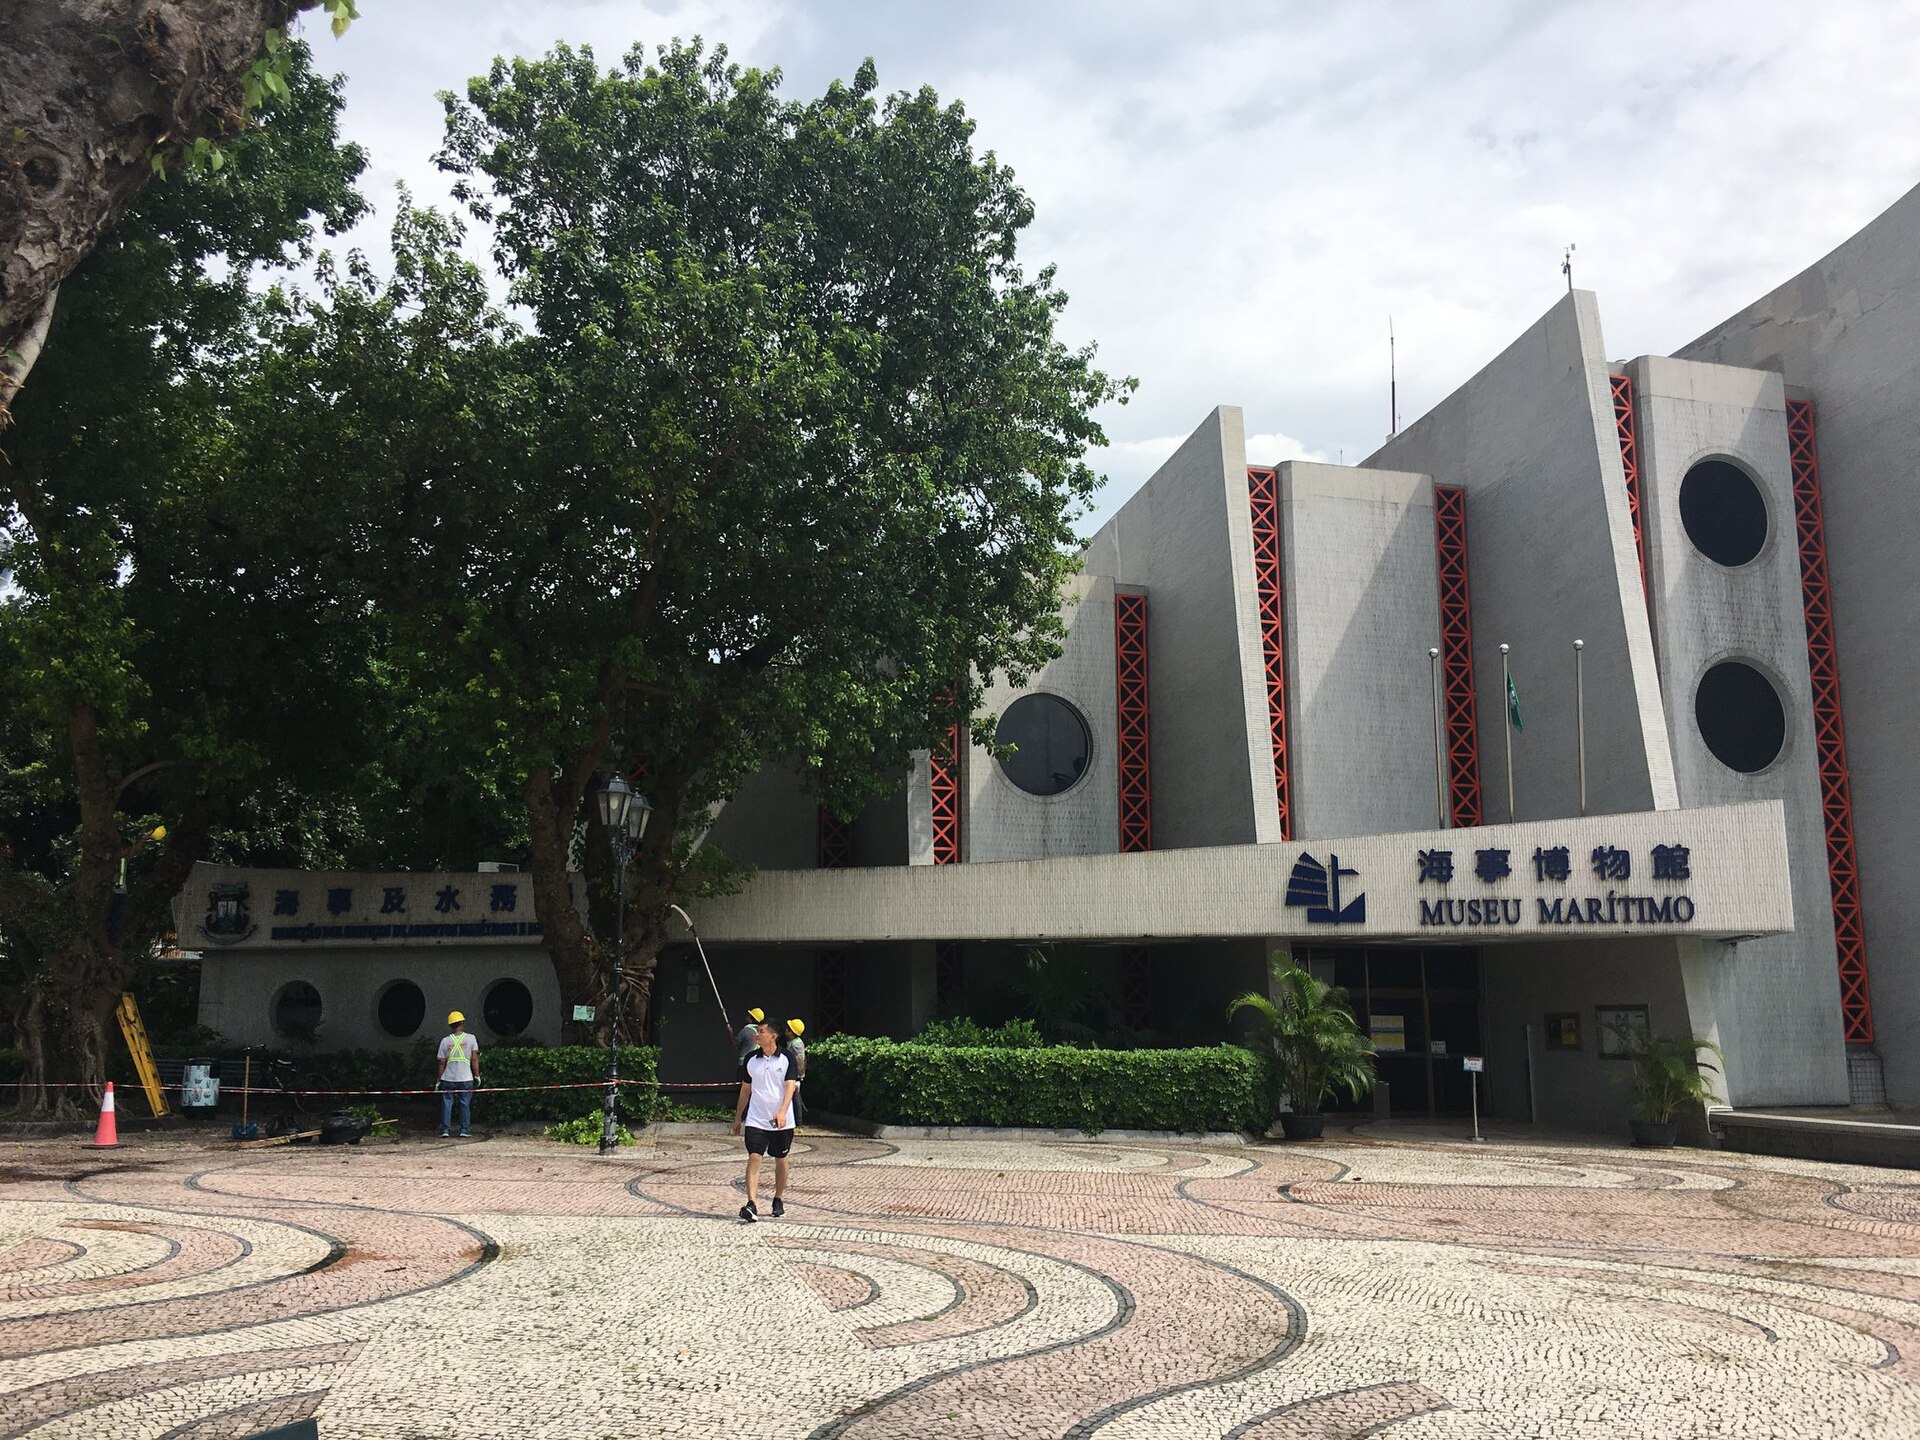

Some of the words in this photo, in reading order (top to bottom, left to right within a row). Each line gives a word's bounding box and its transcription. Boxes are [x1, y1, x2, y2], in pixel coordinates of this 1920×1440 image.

[1418, 844, 1691, 883] 海事博物館
[272, 882, 573, 916] 海事及水務
[1420, 899, 1522, 926] MUSEU
[1537, 891, 1695, 926] MARÍTIMO
